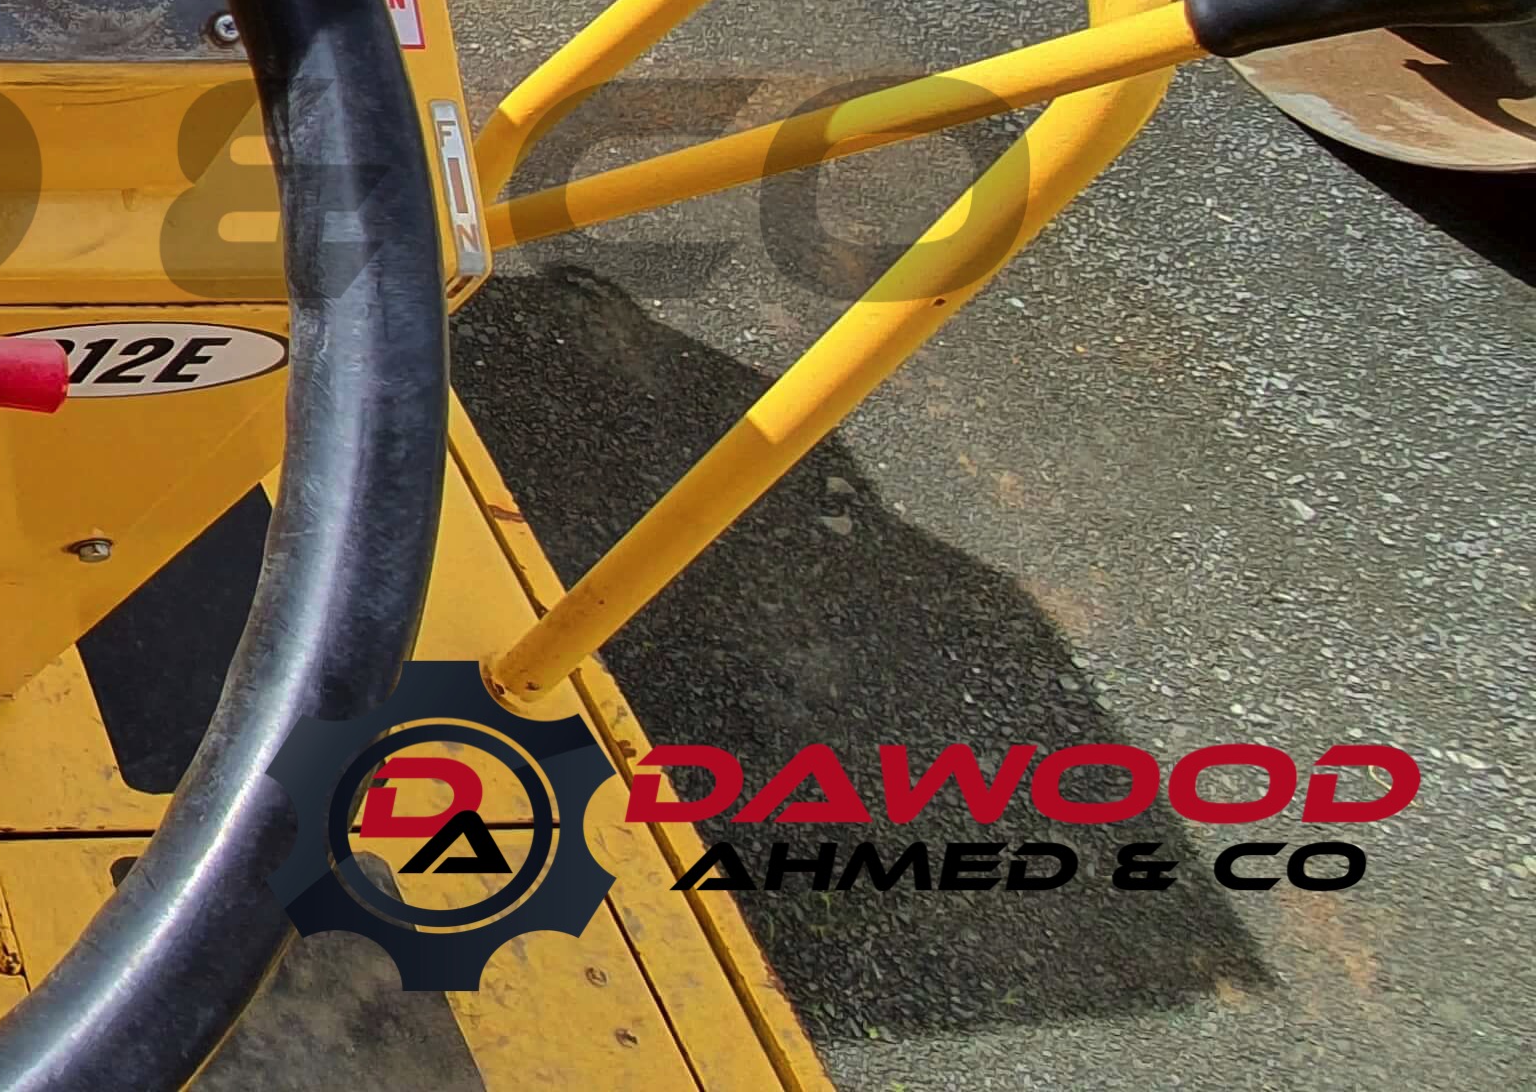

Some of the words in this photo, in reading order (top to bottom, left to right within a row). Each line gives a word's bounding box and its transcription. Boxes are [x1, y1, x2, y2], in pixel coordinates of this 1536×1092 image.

[436, 120, 457, 149] F
[456, 224, 480, 251] N
[55, 337, 232, 384] 12E
